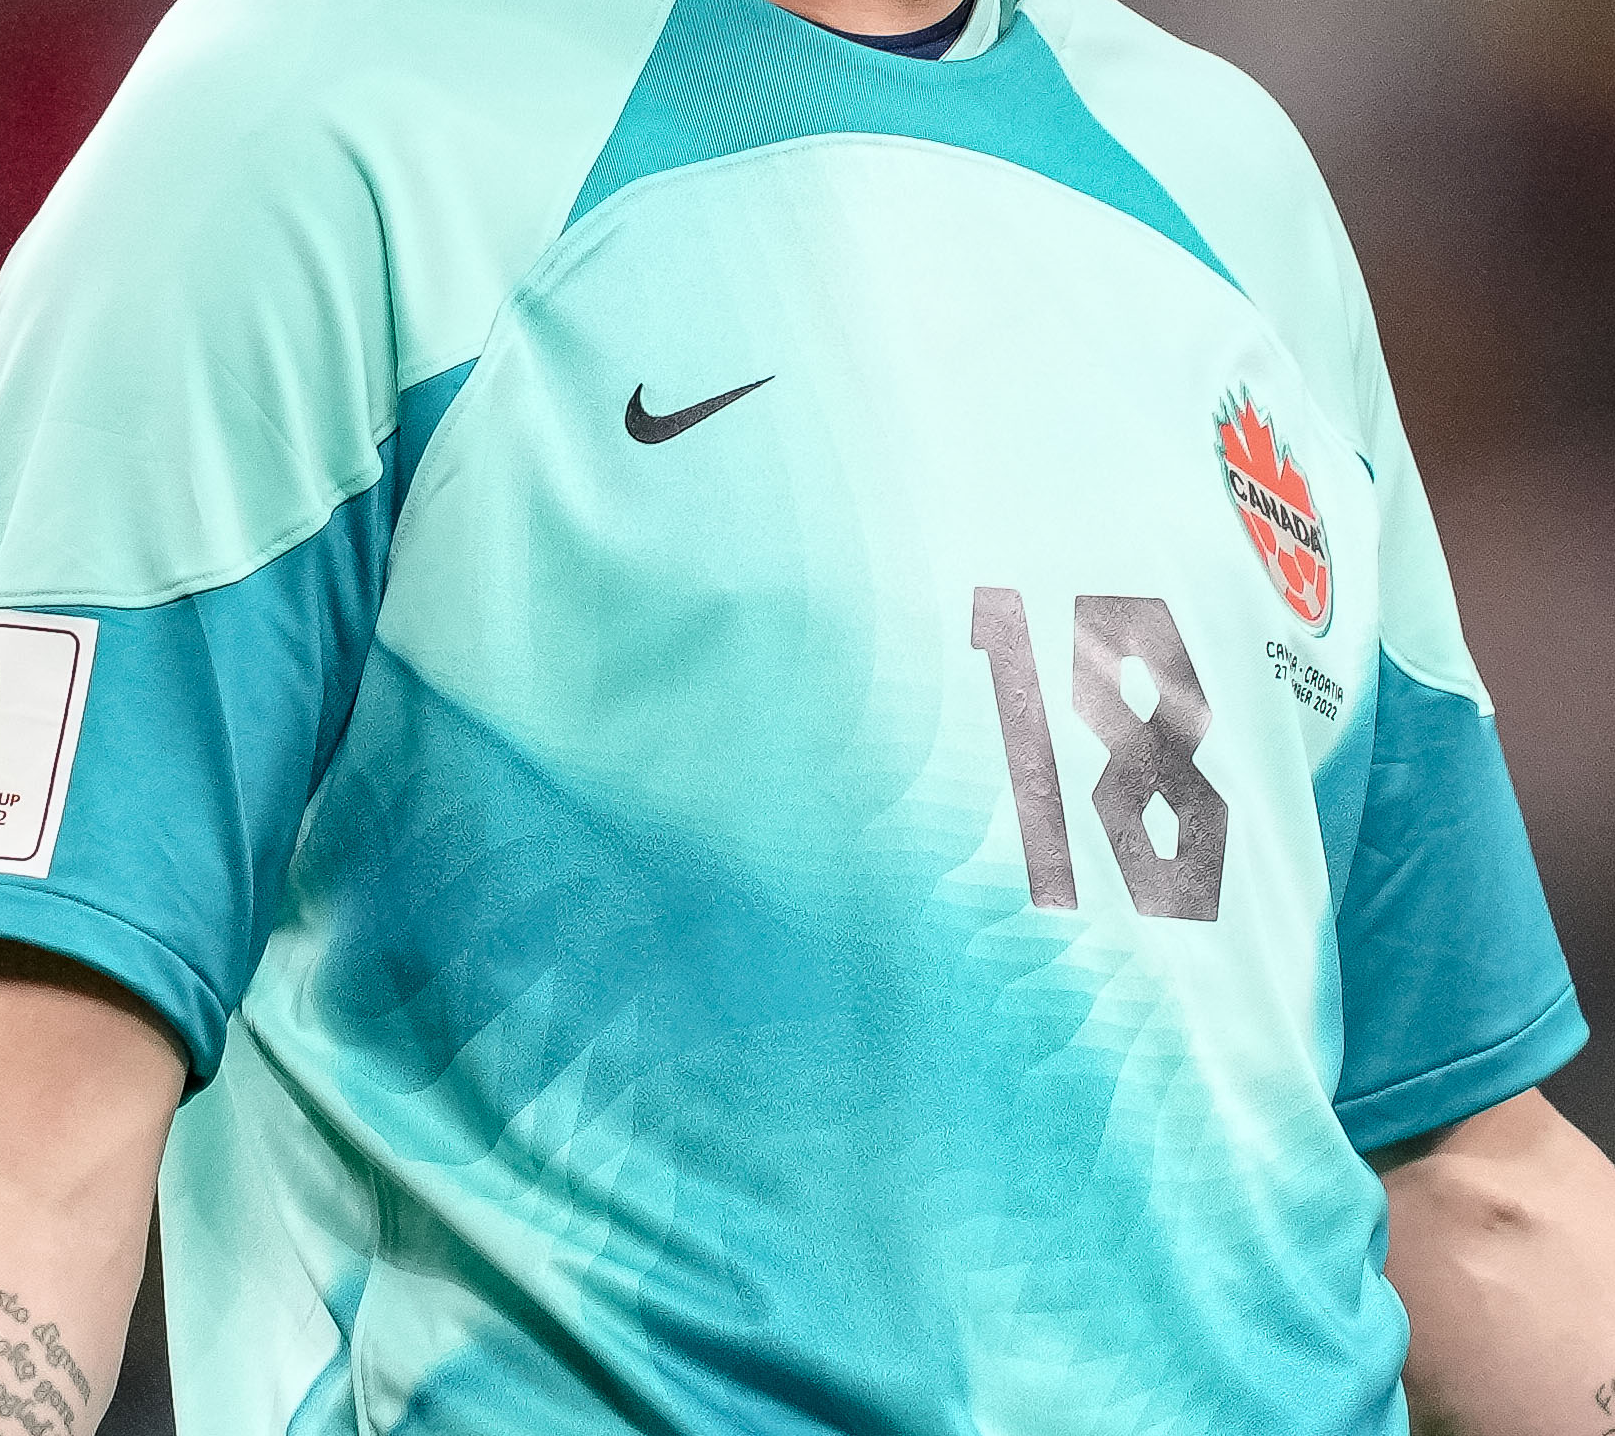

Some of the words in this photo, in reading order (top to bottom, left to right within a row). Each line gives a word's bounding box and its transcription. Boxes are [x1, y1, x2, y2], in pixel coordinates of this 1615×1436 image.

[1229, 469, 1326, 561] CANADA
[1305, 665, 1344, 705] CROATIA
[1312, 695, 1338, 722] 2022
[971, 586, 1228, 922] 18
